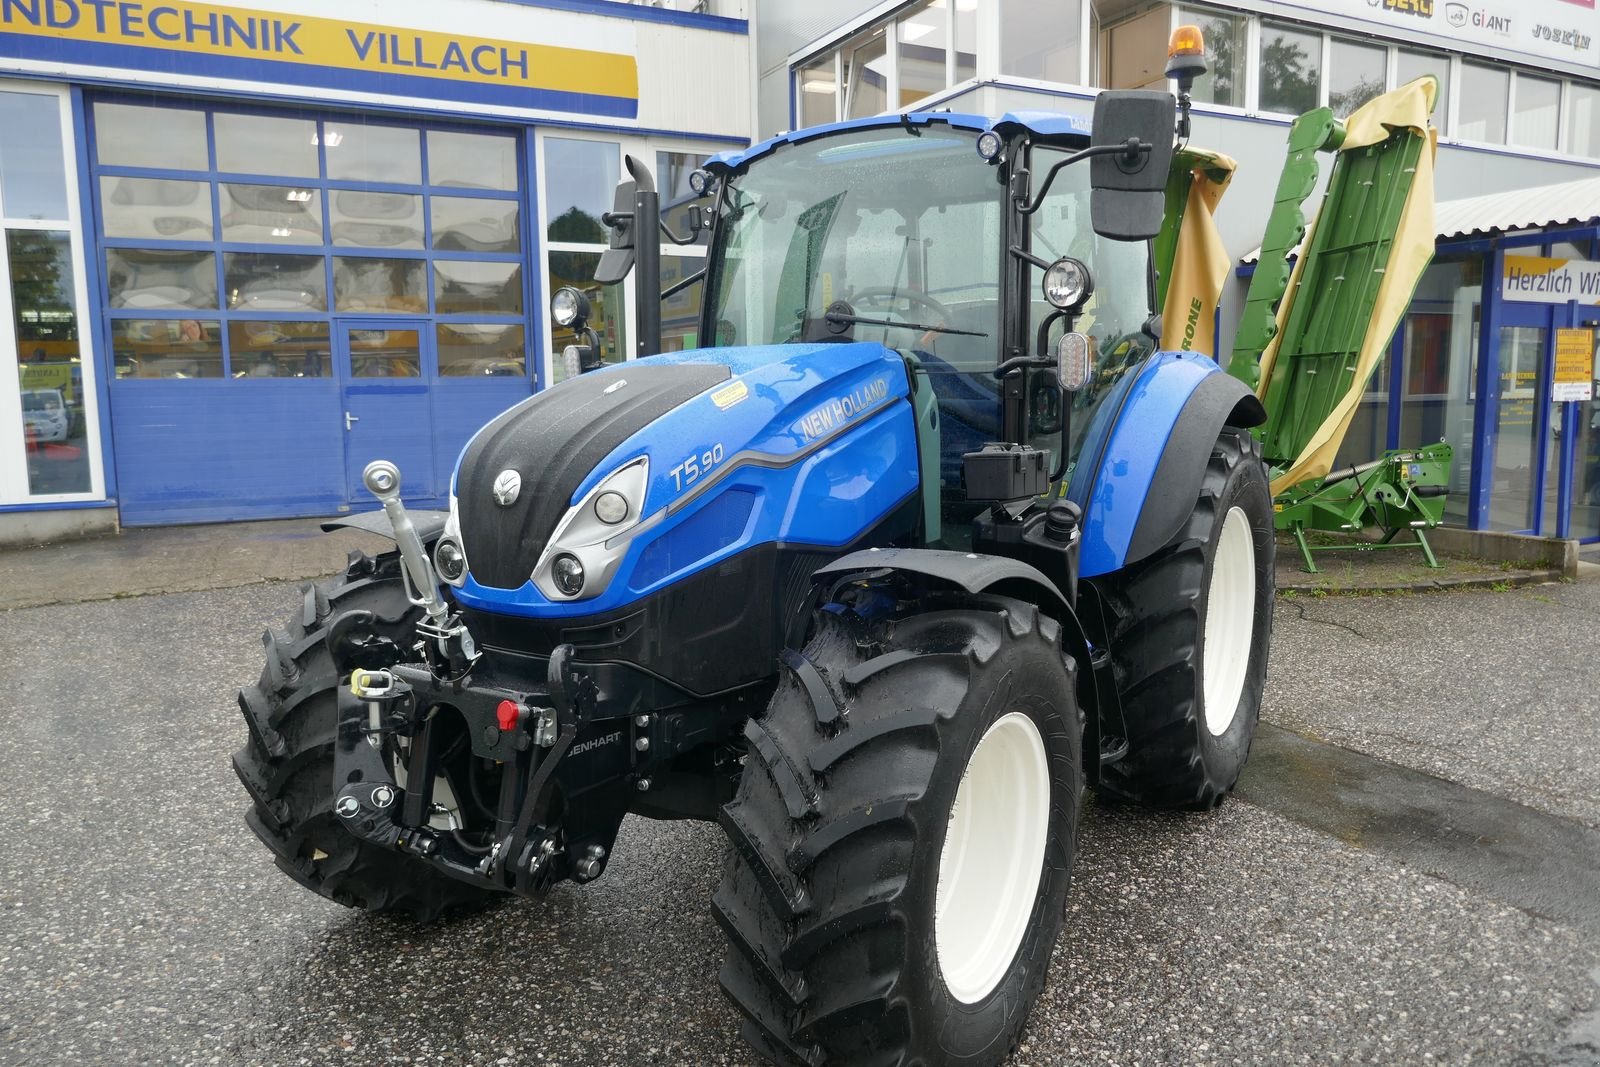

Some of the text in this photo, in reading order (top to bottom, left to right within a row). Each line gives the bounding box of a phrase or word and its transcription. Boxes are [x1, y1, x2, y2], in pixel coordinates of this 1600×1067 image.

[345, 28, 529, 80] VILLACH
[1507, 266, 1600, 296] Herzlich Wi
[800, 378, 888, 441] NEW HOLLAND
[669, 442, 724, 492] T5.90
